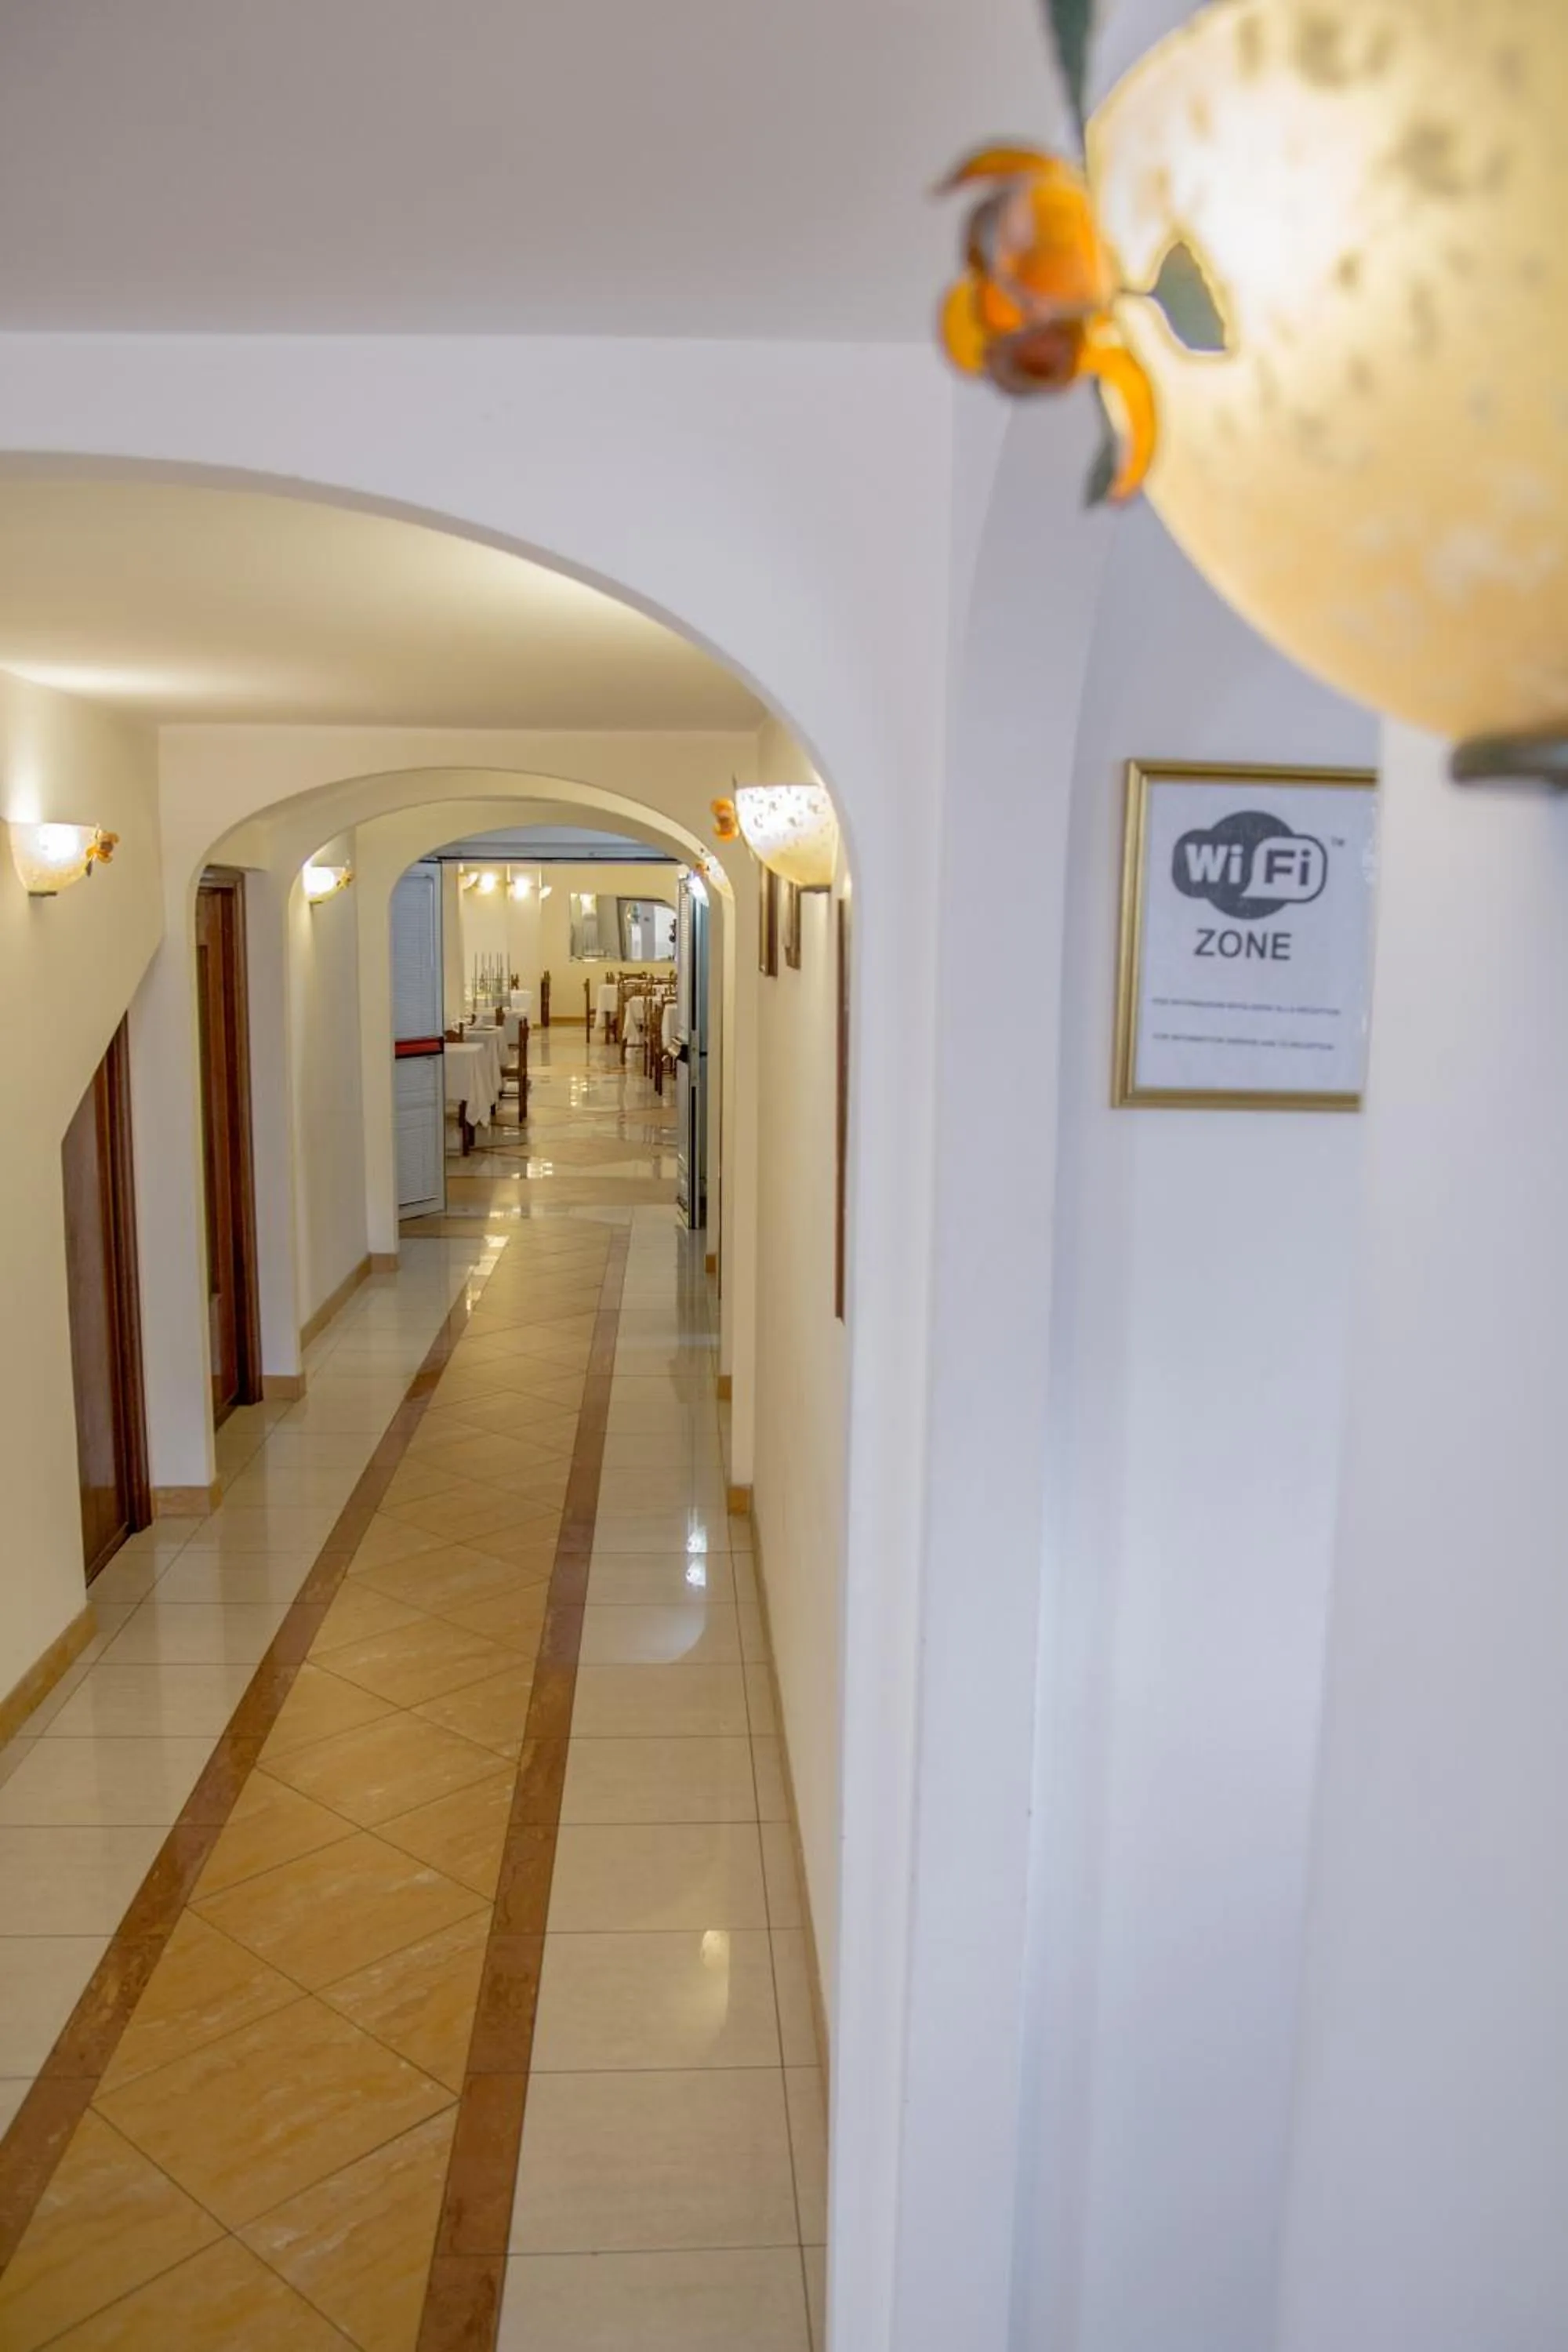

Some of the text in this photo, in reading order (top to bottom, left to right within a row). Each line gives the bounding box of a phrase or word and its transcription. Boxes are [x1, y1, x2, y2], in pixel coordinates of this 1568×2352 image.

[1186, 843, 1310, 887] Wi Fi
[1193, 928, 1292, 960] ZONE
